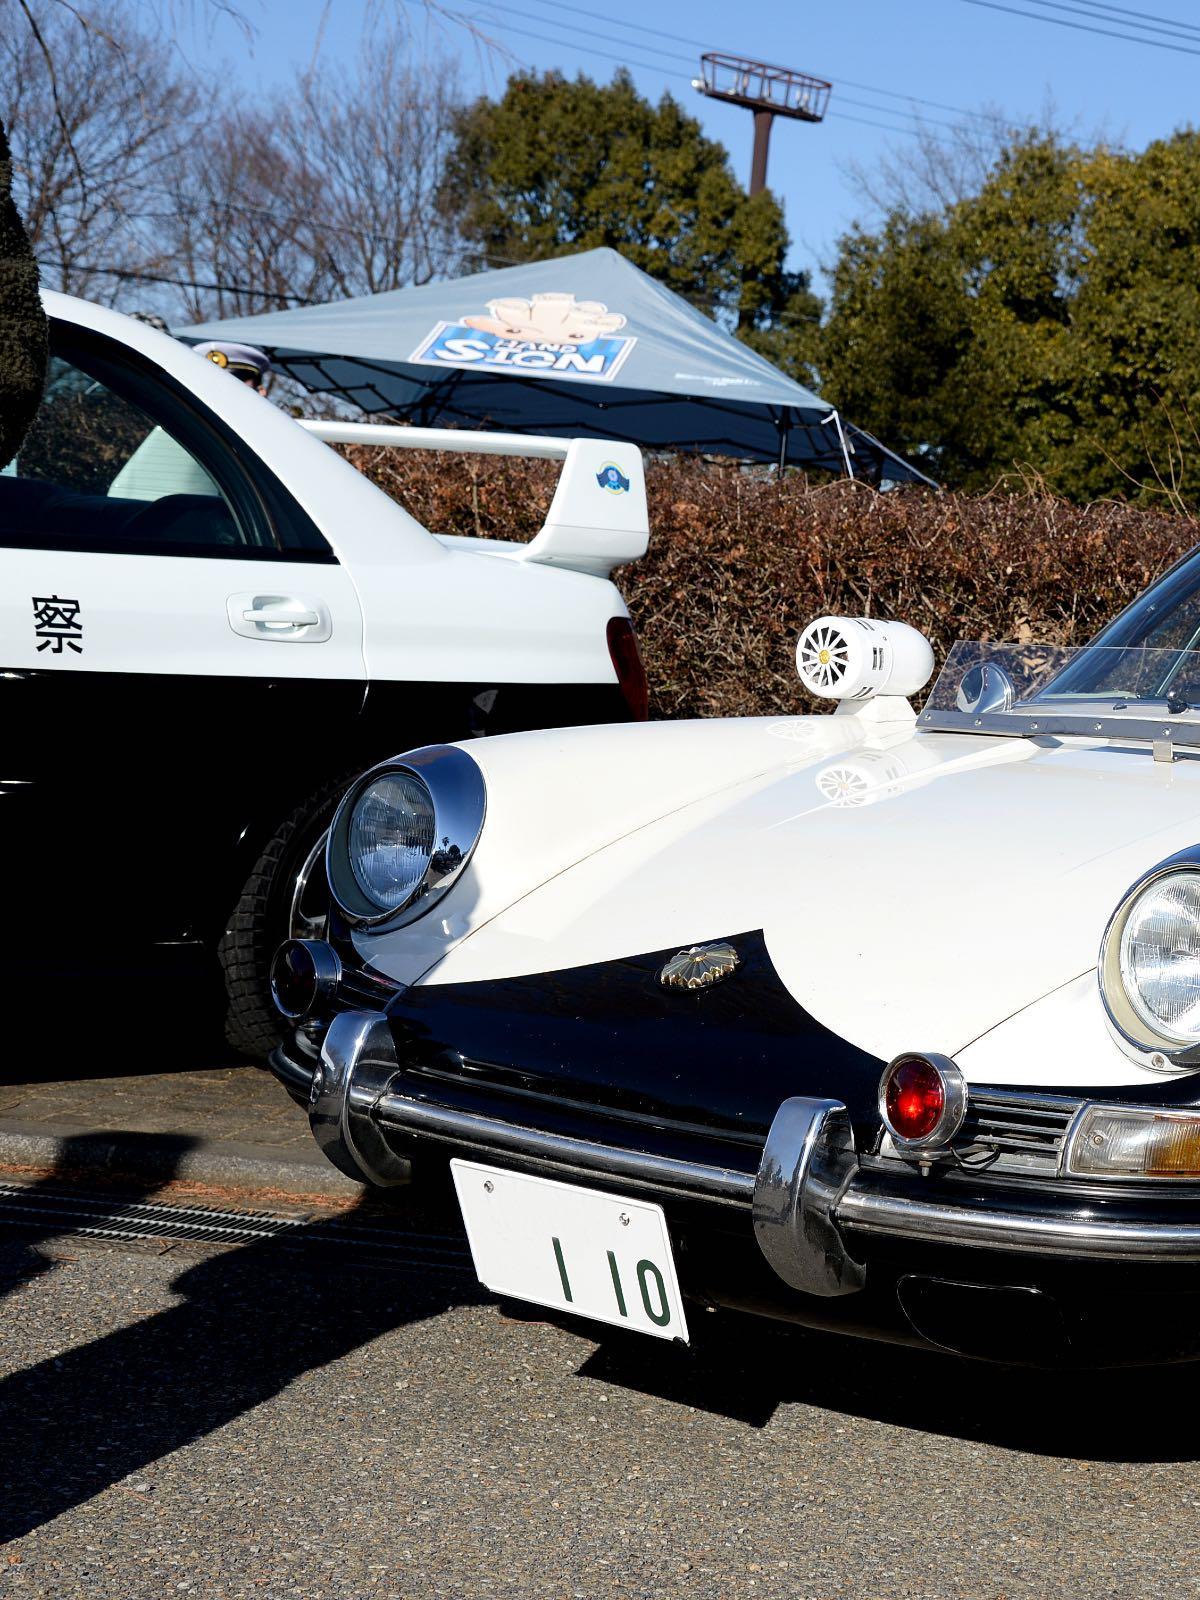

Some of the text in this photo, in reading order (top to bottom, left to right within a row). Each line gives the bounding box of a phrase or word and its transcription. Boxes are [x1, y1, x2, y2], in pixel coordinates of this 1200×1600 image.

[434, 339, 605, 373] SIGN
[493, 339, 579, 353] HAND
[31, 594, 83, 655] 察
[551, 1236, 671, 1328] 110
